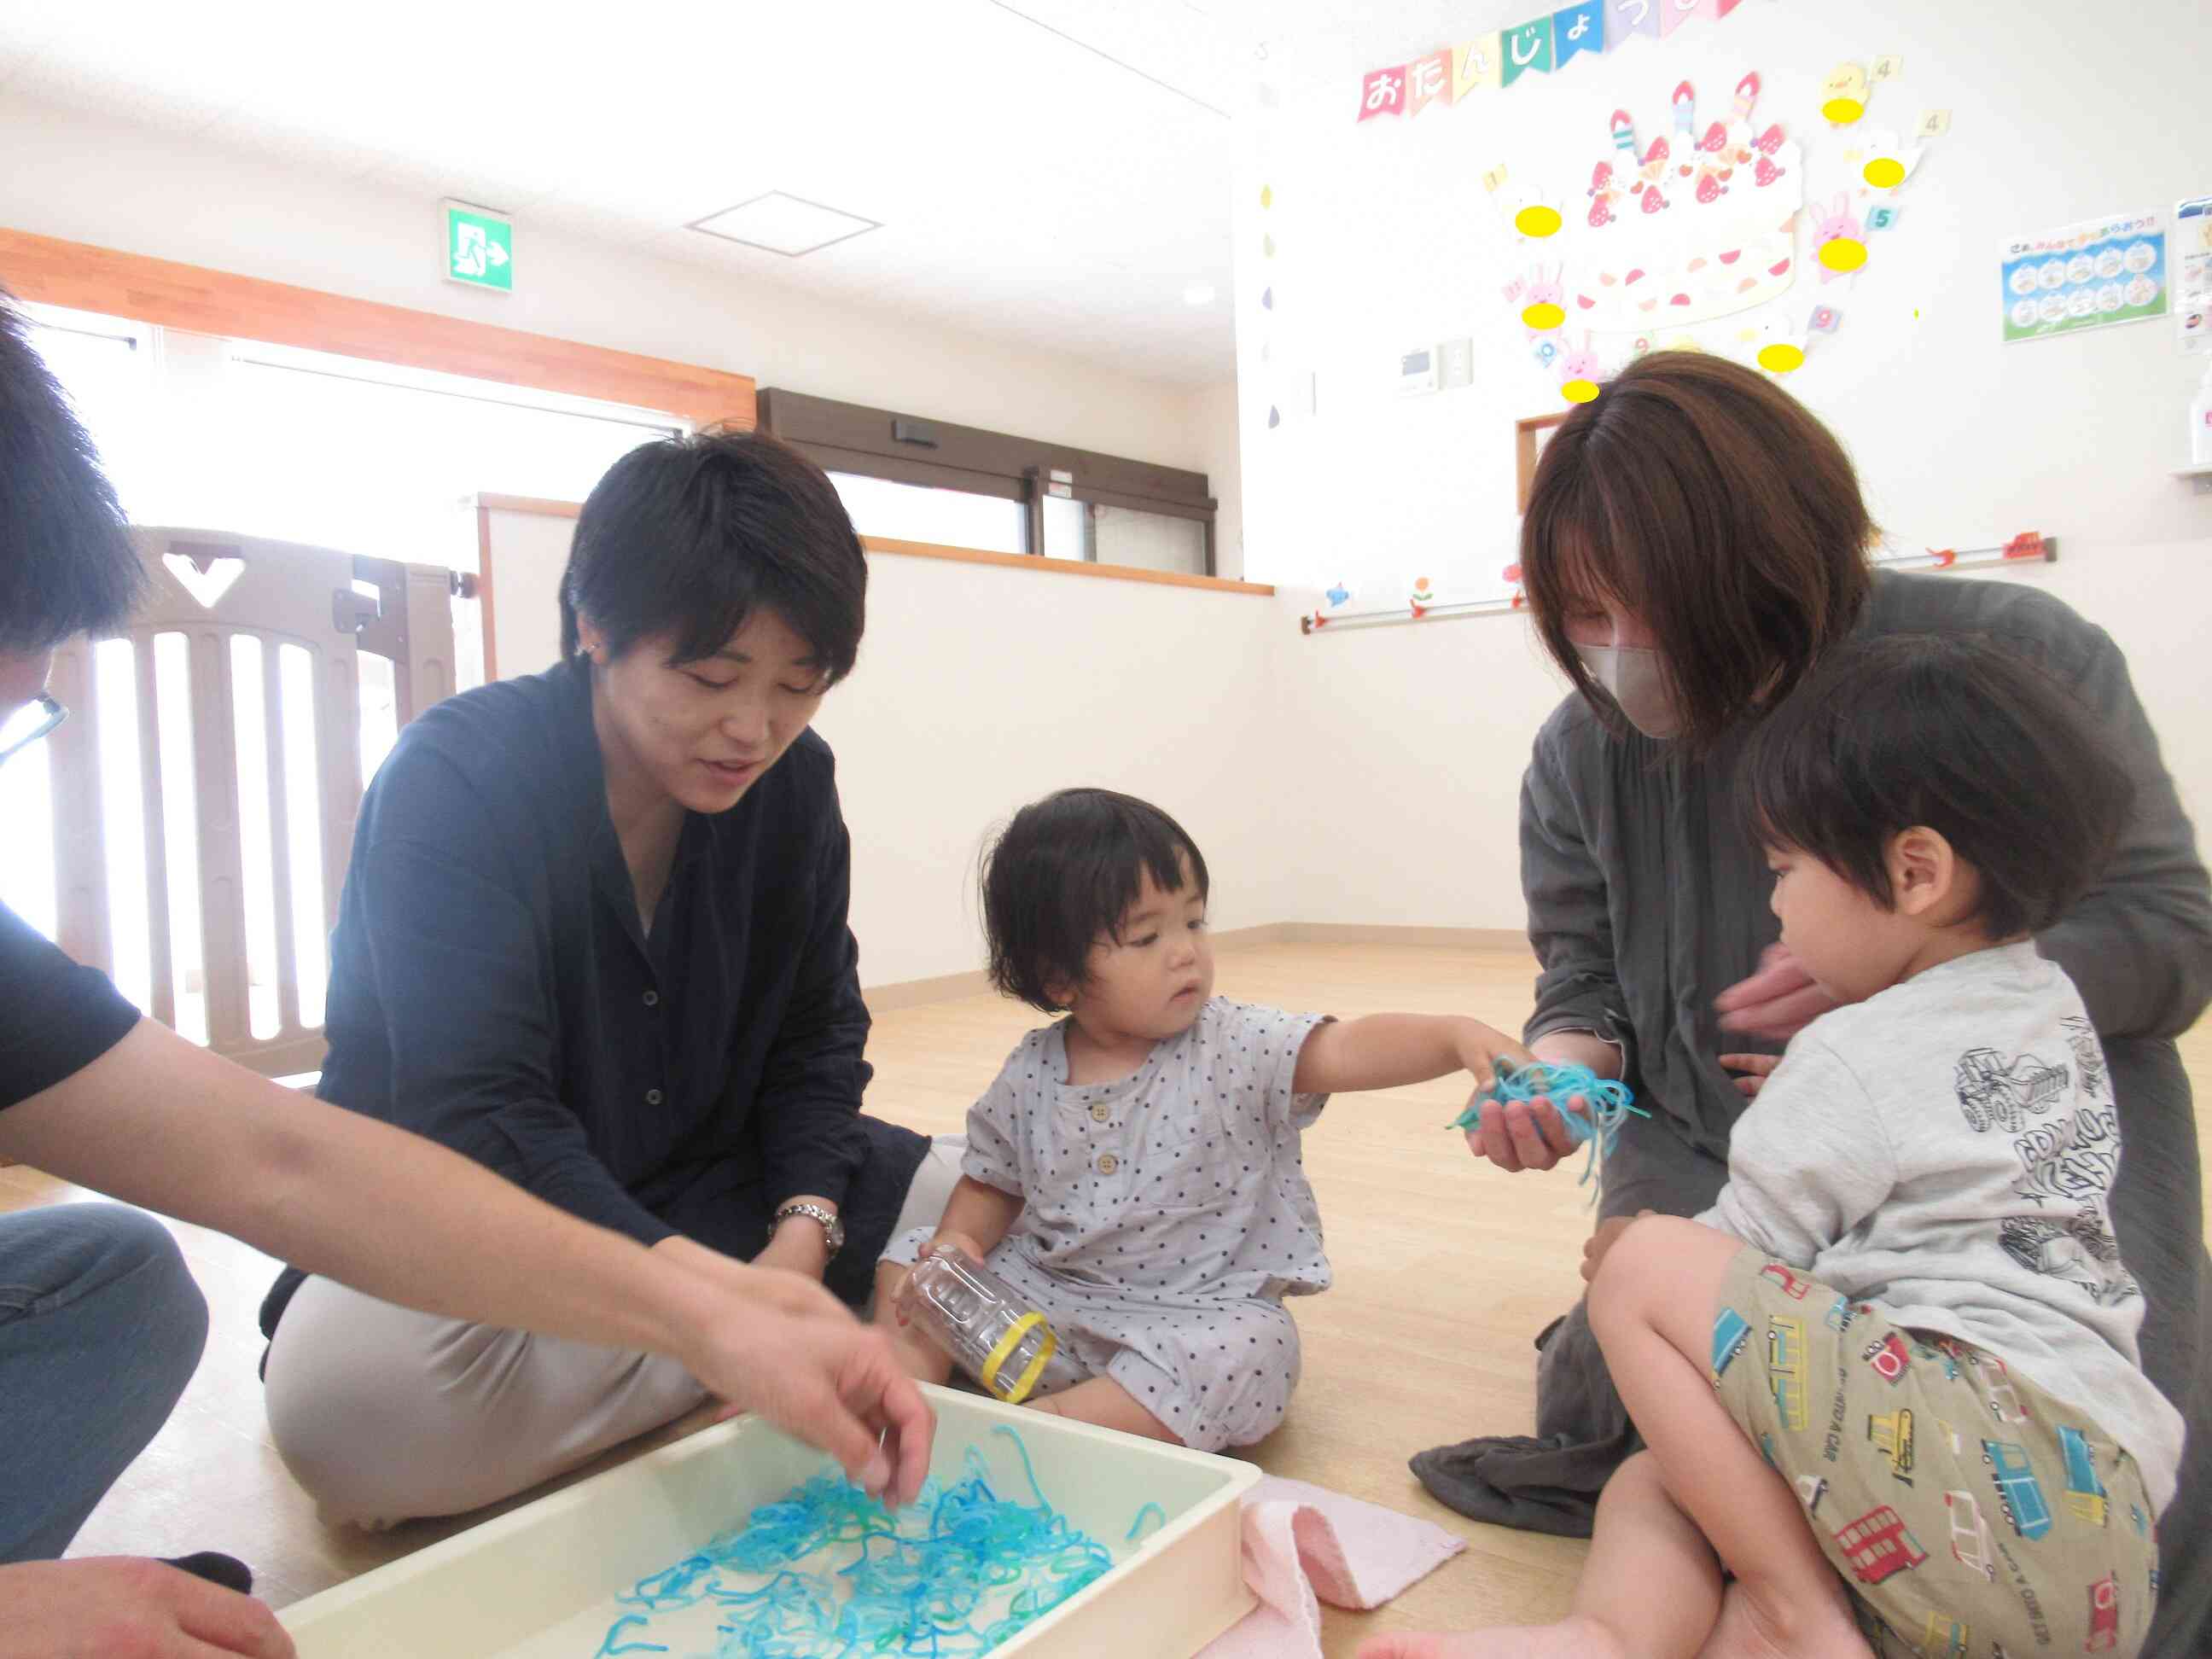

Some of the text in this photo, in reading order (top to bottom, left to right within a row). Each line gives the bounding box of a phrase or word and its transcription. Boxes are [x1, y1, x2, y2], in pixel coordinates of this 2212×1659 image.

[1877, 60, 1892, 78] 4
[1926, 114, 1939, 132] 4
[1875, 208, 1892, 228] 5
[1816, 308, 1832, 328] 9
